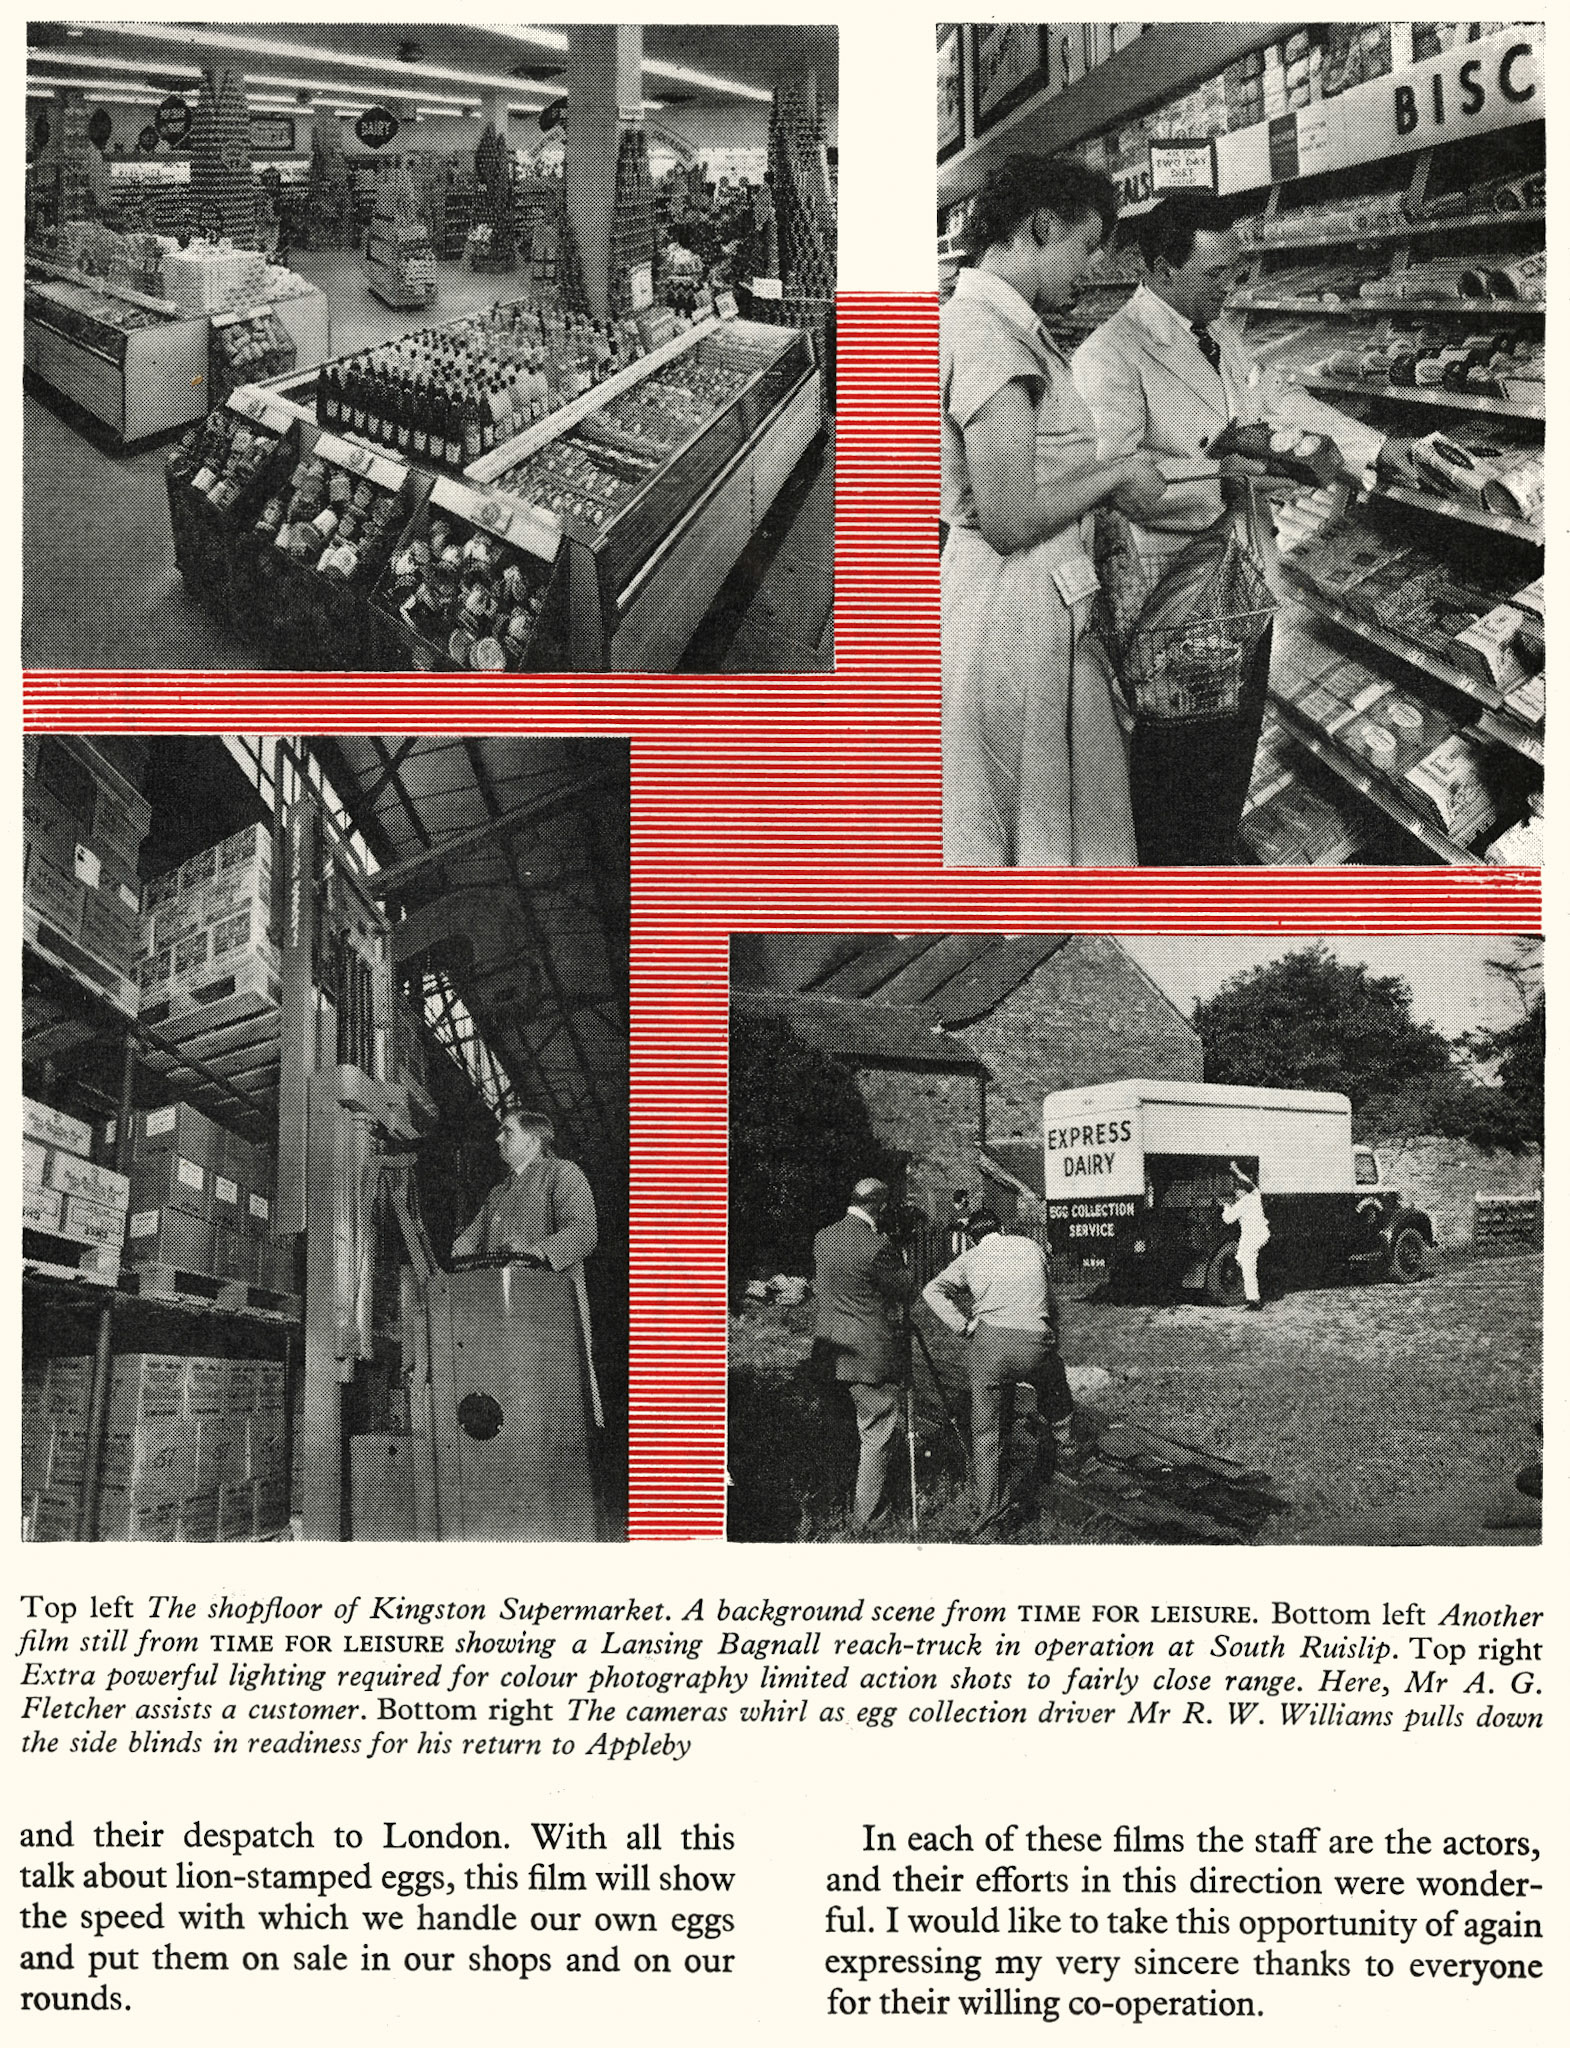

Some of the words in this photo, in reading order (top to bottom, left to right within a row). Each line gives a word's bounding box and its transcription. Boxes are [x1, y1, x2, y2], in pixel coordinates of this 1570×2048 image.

[1395, 43, 1535, 135] BISC
[1048, 1120, 1131, 1150] EXPRESS
[1064, 1152, 1116, 1177] DAIRY
[1049, 1205, 1069, 1219] EGG
[1071, 1202, 1135, 1219] COLLECTION
[1069, 1223, 1116, 1238] SERVICE
[20, 1595, 77, 1624] Top
[89, 1594, 134, 1619] left
[148, 1595, 197, 1619] The
[207, 1595, 323, 1625] shopfloor
[333, 1595, 362, 1625] of
[369, 1595, 486, 1625] Kingston
[499, 1597, 671, 1626] Supermarket.
[681, 1598, 704, 1621] A
[717, 1598, 865, 1627] background
[871, 1605, 936, 1622] scene
[941, 1598, 1006, 1628] from
[1017, 1604, 1081, 1623] TIME
[1091, 1605, 1140, 1623] FOR
[1150, 1605, 1258, 1624] LEISURE.
[1271, 1601, 1371, 1626] Bottom
[1382, 1601, 1426, 1626] left
[1437, 1603, 1544, 1628] Another
[14, 1628, 69, 1658] film
[79, 1628, 129, 1652] still
[133, 1628, 199, 1658] from
[209, 1634, 274, 1653] TIME
[284, 1635, 333, 1653] FOR
[343, 1635, 445, 1653] LEISURE
[455, 1630, 557, 1660] showing
[571, 1638, 587, 1655] a
[600, 1631, 704, 1660] Lansing
[717, 1631, 821, 1661] Bagnall
[834, 1632, 982, 1656] reach-truck
[995, 1632, 1021, 1656] in
[1034, 1633, 1154, 1662] operation
[1168, 1639, 1195, 1658] at
[1209, 1634, 1285, 1659] South
[1299, 1635, 1398, 1665] Ruislip.
[1408, 1636, 1466, 1666] Top
[1478, 1637, 1544, 1667] right
[19, 1662, 96, 1686] Extra
[104, 1662, 219, 1691] powerful
[229, 1662, 327, 1692] lighting
[337, 1663, 442, 1693] required
[448, 1663, 490, 1693] for
[500, 1664, 578, 1688] colour
[586, 1664, 749, 1695] photography
[760, 1664, 850, 1689] limited
[859, 1665, 937, 1690] action
[950, 1666, 1012, 1690] shots
[1027, 1672, 1051, 1690] to
[1061, 1666, 1139, 1696] fairly
[1153, 1667, 1212, 1691] close
[1225, 1675, 1303, 1697] range.
[1317, 1669, 1390, 1697] Here,
[1403, 1670, 1449, 1693] Mr
[1462, 1671, 1494, 1695] A.
[1510, 1671, 1542, 1695] G.
[20, 1695, 127, 1720] Fletcher
[135, 1696, 213, 1720] assists
[221, 1704, 237, 1720] a
[248, 1702, 367, 1721] customer.
[376, 1697, 477, 1721] Bottom
[488, 1697, 554, 1727] right
[568, 1698, 616, 1722] The
[626, 1705, 728, 1722] cameras
[739, 1698, 809, 1722] whirl
[819, 1706, 845, 1722] as
[856, 1706, 898, 1728] egg
[908, 1699, 1027, 1724] collection
[1038, 1700, 1116, 1724] driver
[1127, 1700, 1171, 1724] Mr
[1182, 1701, 1213, 1725] R.
[1228, 1701, 1265, 1725] W.
[1280, 1702, 1394, 1727] Williams
[1402, 1704, 1465, 1732] pulls
[1476, 1704, 1543, 1729] down
[21, 1729, 59, 1753] the
[69, 1729, 118, 1753] side
[128, 1729, 203, 1753] blinds
[213, 1730, 238, 1754] in
[247, 1730, 362, 1754] readiness
[366, 1730, 409, 1759] for
[417, 1730, 453, 1755] his
[462, 1736, 541, 1755] return
[552, 1737, 575, 1755] to
[584, 1732, 692, 1762] Appleby
[20, 1820, 75, 1848] and
[93, 1820, 165, 1848] their
[183, 1820, 315, 1856] despatch
[333, 1826, 363, 1849] to
[382, 1821, 510, 1850] London.
[530, 1822, 608, 1850] With
[626, 1822, 662, 1851] all
[680, 1822, 735, 1851] this
[862, 1824, 897, 1852] In
[907, 1824, 975, 1852] each
[985, 1824, 1019, 1852] of
[1025, 1824, 1102, 1852] these
[1113, 1824, 1185, 1853] films
[1196, 1825, 1244, 1853] the
[1255, 1826, 1322, 1854] staff
[1328, 1835, 1374, 1855] are
[1384, 1827, 1432, 1855] the
[1443, 1834, 1540, 1862] actors,
[19, 1860, 75, 1889] talk
[82, 1861, 168, 1889] about
[175, 1861, 373, 1898] lion-stamped
[381, 1870, 455, 1898] eggs,
[463, 1862, 519, 1890] this
[527, 1862, 587, 1891] film
[595, 1863, 651, 1891] will
[659, 1863, 736, 1892] show
[826, 1864, 882, 1892] and
[892, 1864, 965, 1893] their
[975, 1865, 1069, 1893] efforts
[1081, 1865, 1112, 1893] in
[1122, 1865, 1177, 1894] this
[1189, 1865, 1323, 1895] direction
[1334, 1876, 1405, 1896] were
[1416, 1869, 1543, 1897] wonder-
[19, 1901, 68, 1929] the
[80, 1901, 165, 1938] speed
[178, 1902, 246, 1930] with
[257, 1902, 349, 1930] which
[361, 1911, 404, 1931] we
[416, 1903, 517, 1931] handle
[530, 1912, 582, 1931] our
[594, 1912, 658, 1932] own
[671, 1913, 735, 1940] eggs
[824, 1946, 982, 1982] expressing
[994, 1955, 1043, 1982] my
[1055, 1955, 1121, 1983] very
[1134, 1947, 1240, 1975] sincere
[1253, 1948, 1351, 1977] thanks
[1364, 1955, 1394, 1978] to
[1409, 1958, 1544, 1986] everyone
[827, 1987, 872, 2015] for
[879, 1987, 951, 2015] their
[958, 1987, 1061, 2023] willing
[1068, 1988, 1264, 2024] co-operation.
